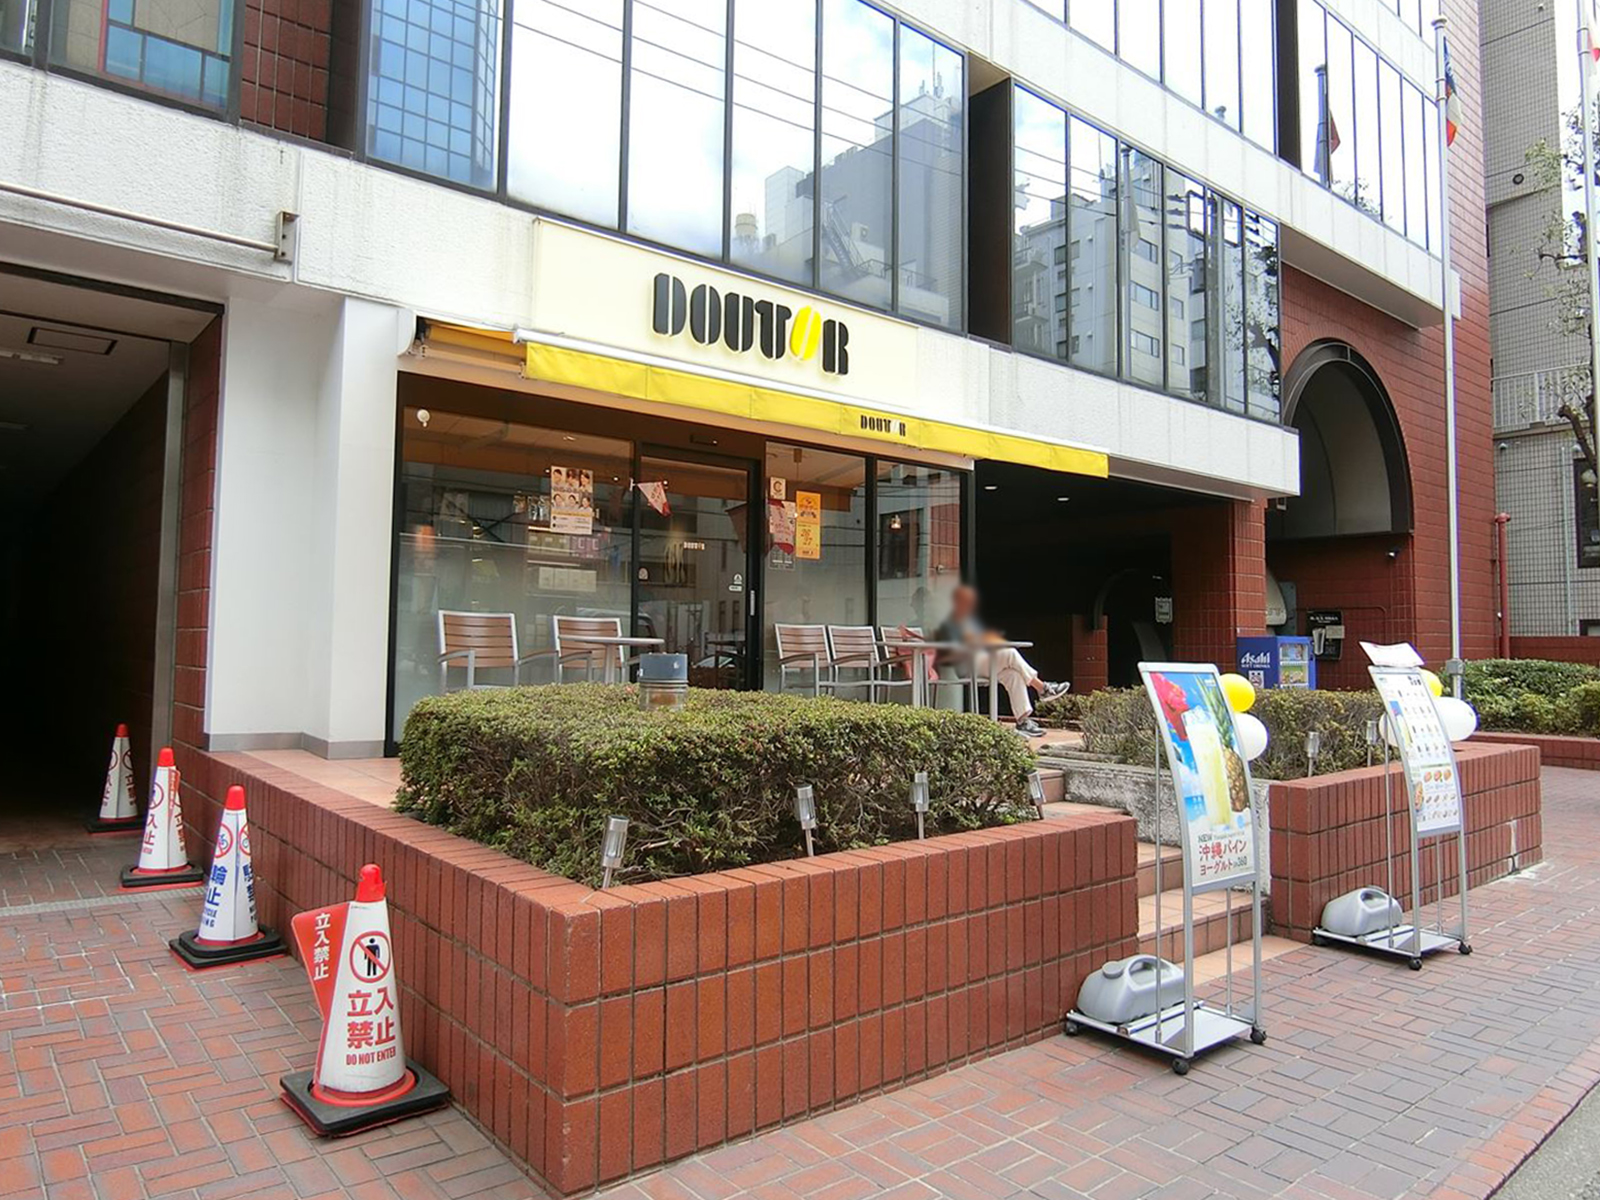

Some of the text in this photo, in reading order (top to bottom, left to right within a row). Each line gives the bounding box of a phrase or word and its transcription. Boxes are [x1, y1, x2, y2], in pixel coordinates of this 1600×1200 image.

[652, 272, 849, 375] DOUTOR
[860, 414, 906, 437] DOUTOR
[1241, 651, 1270, 664] Asahi
[1200, 859, 1234, 876] ヨーグルト
[313, 912, 332, 981] 立入禁止
[346, 986, 395, 1017] 立入
[346, 1016, 396, 1049] 禁止
[346, 1045, 396, 1066] DO NOT ENTER
